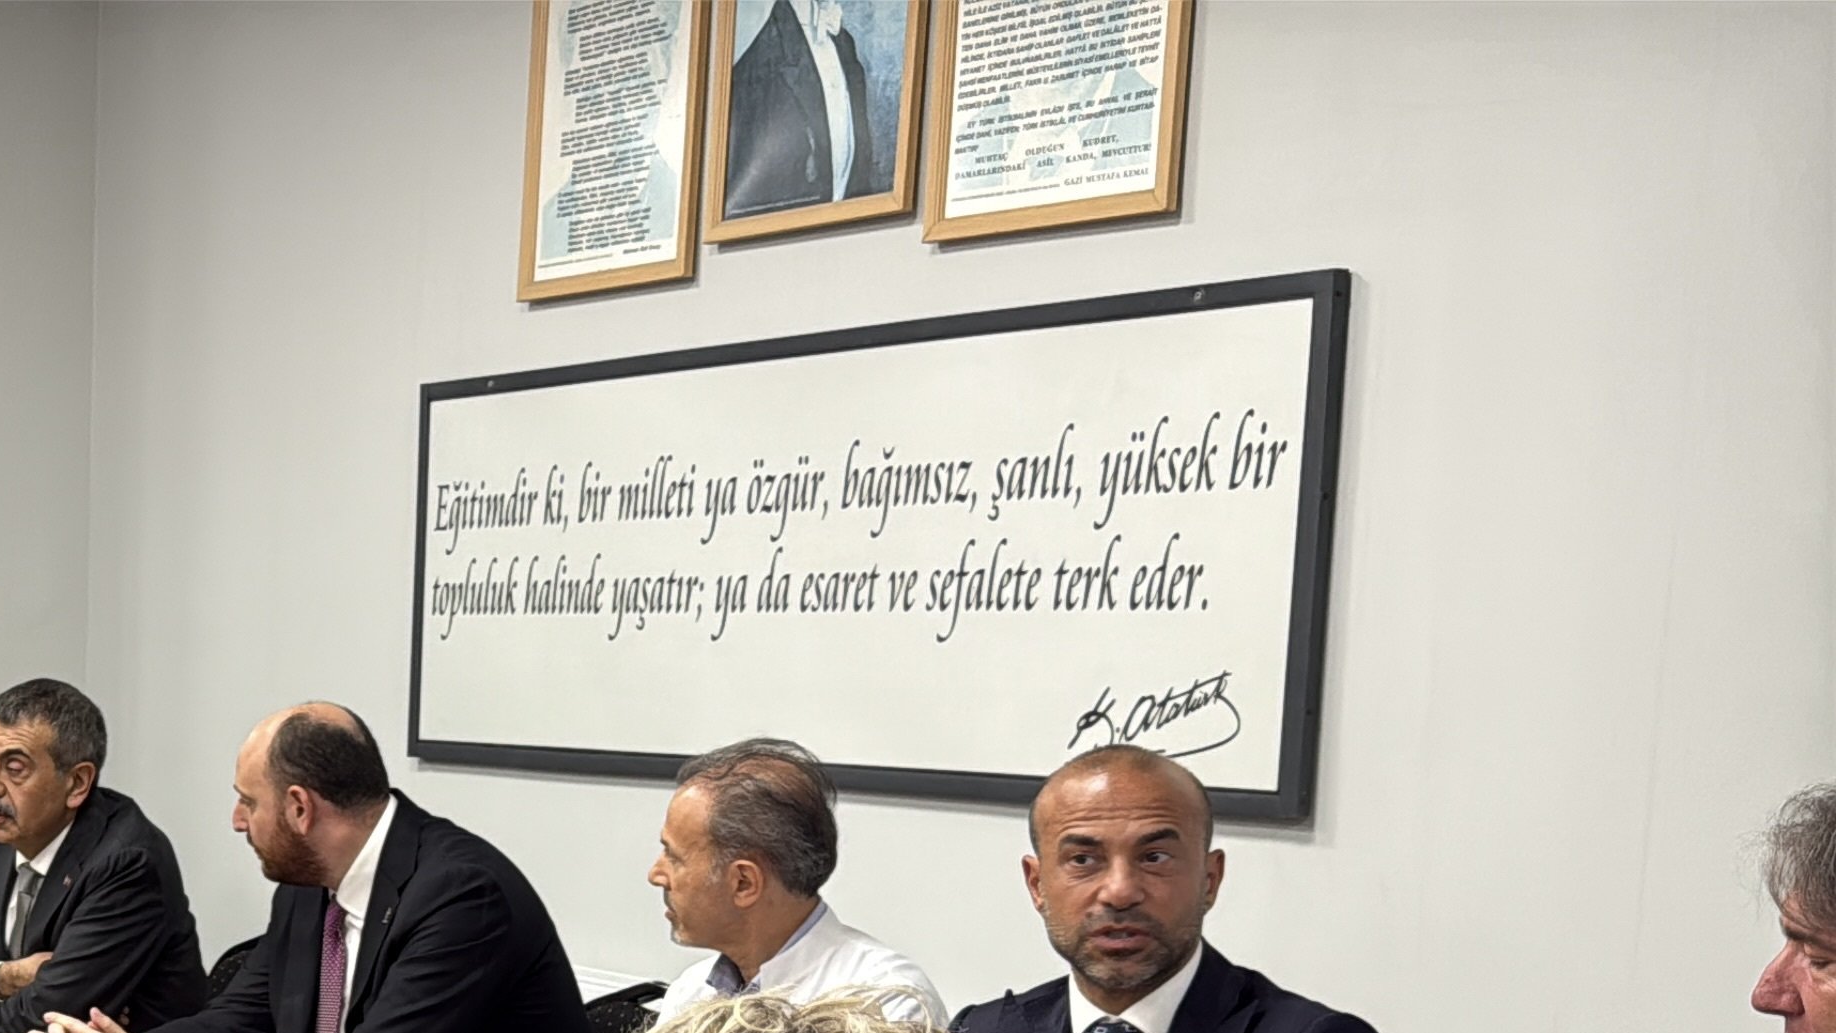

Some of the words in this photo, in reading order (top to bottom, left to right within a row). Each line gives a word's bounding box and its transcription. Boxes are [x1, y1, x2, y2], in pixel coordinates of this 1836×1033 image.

[434, 466, 539, 555] Eğitimdir
[543, 464, 568, 532] ki,
[577, 461, 612, 524] bir
[618, 454, 696, 520] milleti
[700, 476, 737, 545] ya
[746, 456, 829, 542] özgür,
[840, 439, 977, 538] bağımsız,
[987, 423, 1082, 521] şanlı,
[1093, 411, 1221, 530] yüksek
[1228, 408, 1288, 490] bir
[431, 556, 519, 640] topluluk
[523, 553, 605, 615] halinde
[607, 568, 705, 641] yaşatır;
[710, 573, 748, 642] ya
[756, 546, 791, 613] da
[799, 563, 880, 613] esaret
[888, 570, 919, 612] ve
[925, 538, 1042, 643] sefalete
[1053, 534, 1121, 612] terk
[1129, 532, 1208, 611] eder.
